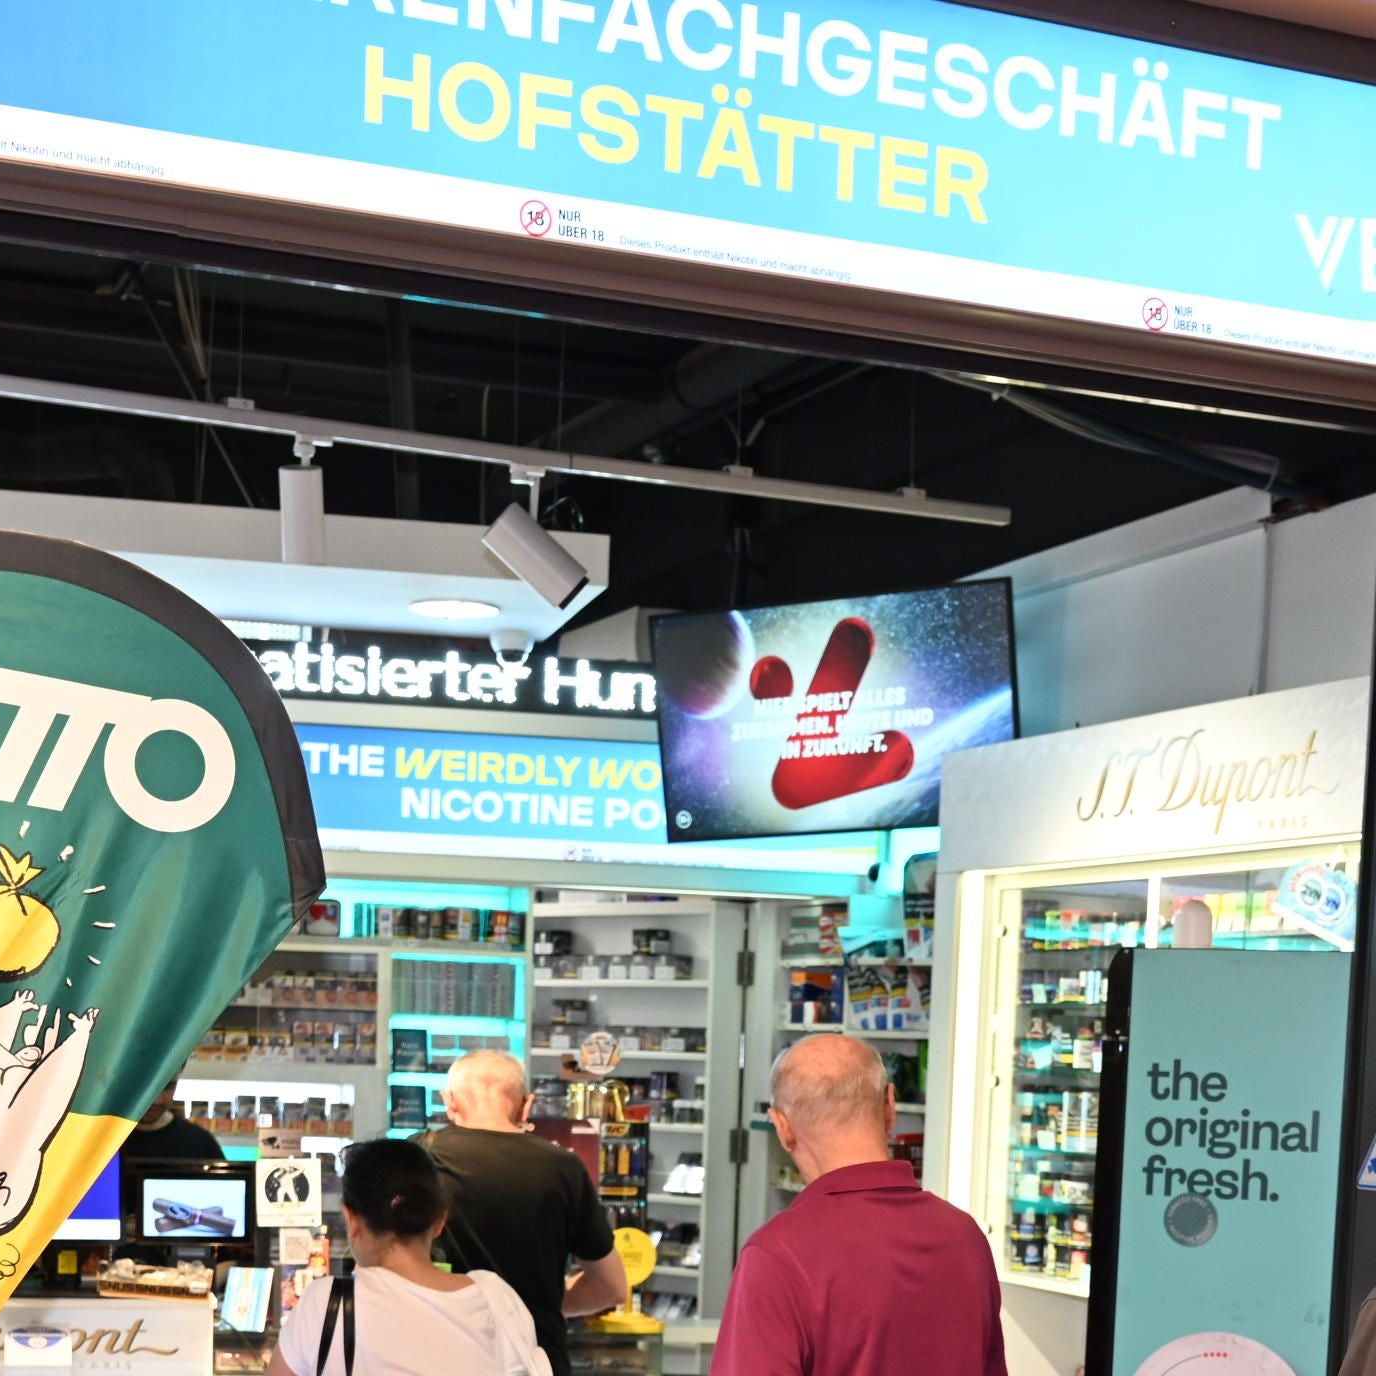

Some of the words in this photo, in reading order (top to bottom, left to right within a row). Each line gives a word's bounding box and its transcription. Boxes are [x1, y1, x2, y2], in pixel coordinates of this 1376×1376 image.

[51, 148, 74, 161] und
[364, 45, 989, 224] HOFSTÄTTER
[558, 208, 581, 222] NUR
[558, 223, 587, 240] ÜBER
[591, 230, 605, 242] 18
[1174, 305, 1193, 318] NUR
[1201, 323, 1212, 335] 18
[258, 641, 531, 703] atisierter
[302, 742, 385, 777] THE
[395, 747, 581, 787] WEIRDLY
[1157, 729, 1340, 835] Dupont
[400, 787, 593, 827] NICOTINE
[1146, 1059, 1228, 1101] the
[1144, 1108, 1320, 1160] original
[1142, 1155, 1279, 1202] fresh.
